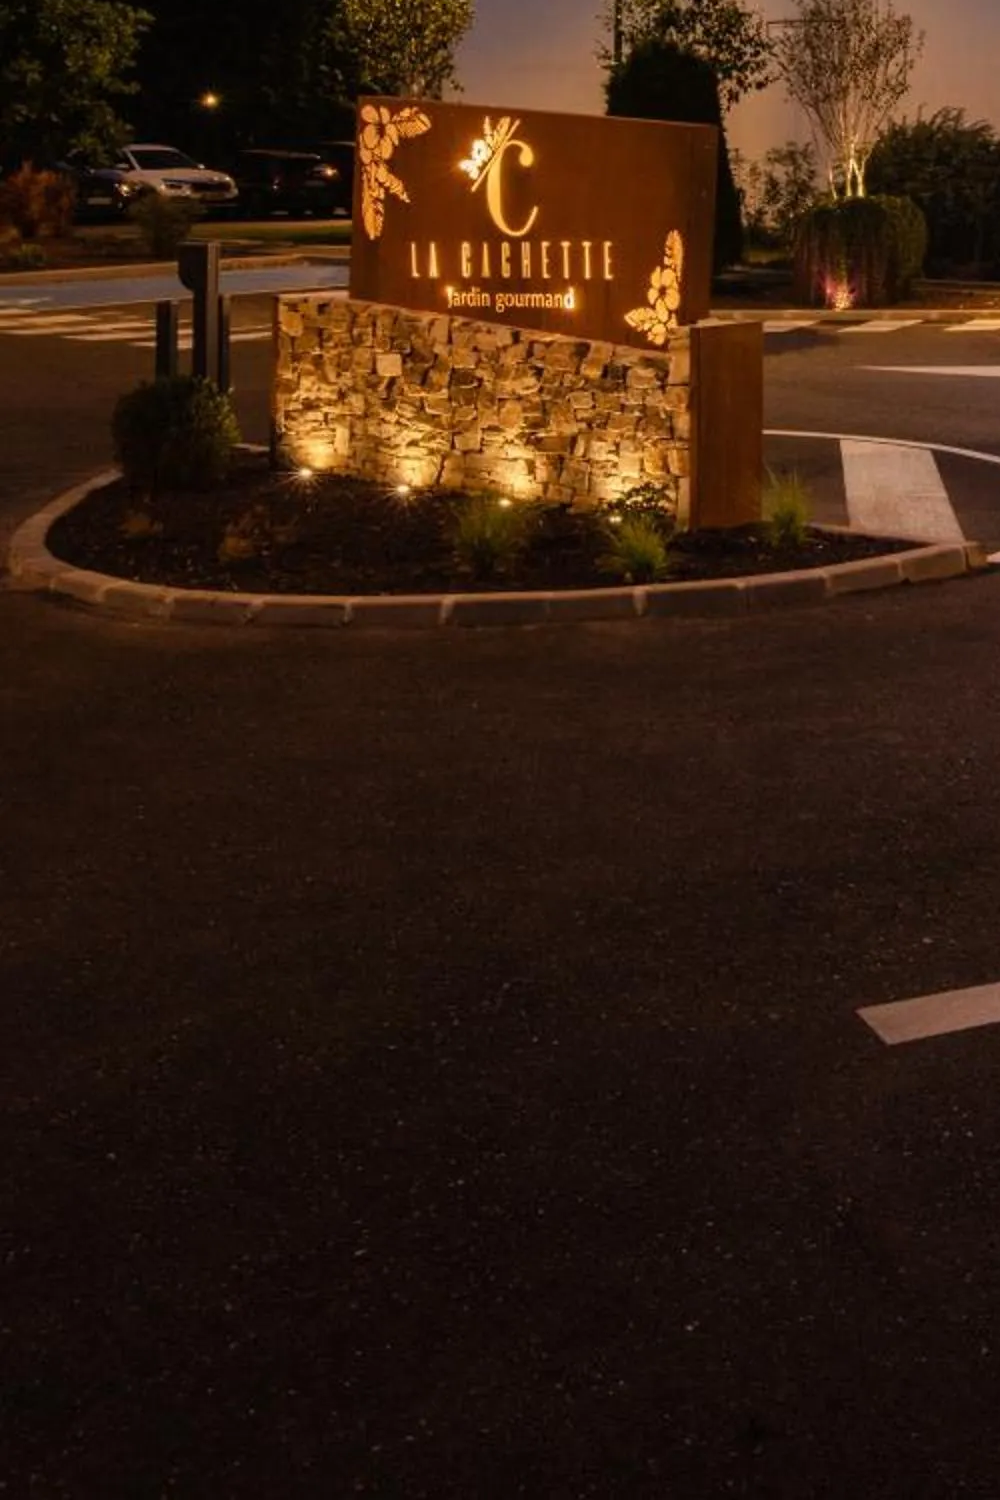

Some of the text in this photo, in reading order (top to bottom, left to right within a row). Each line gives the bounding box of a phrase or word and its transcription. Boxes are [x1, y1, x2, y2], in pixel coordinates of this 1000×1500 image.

[486, 139, 538, 237] C
[411, 241, 439, 279] LA
[446, 287, 575, 313] Jardin gourmand
